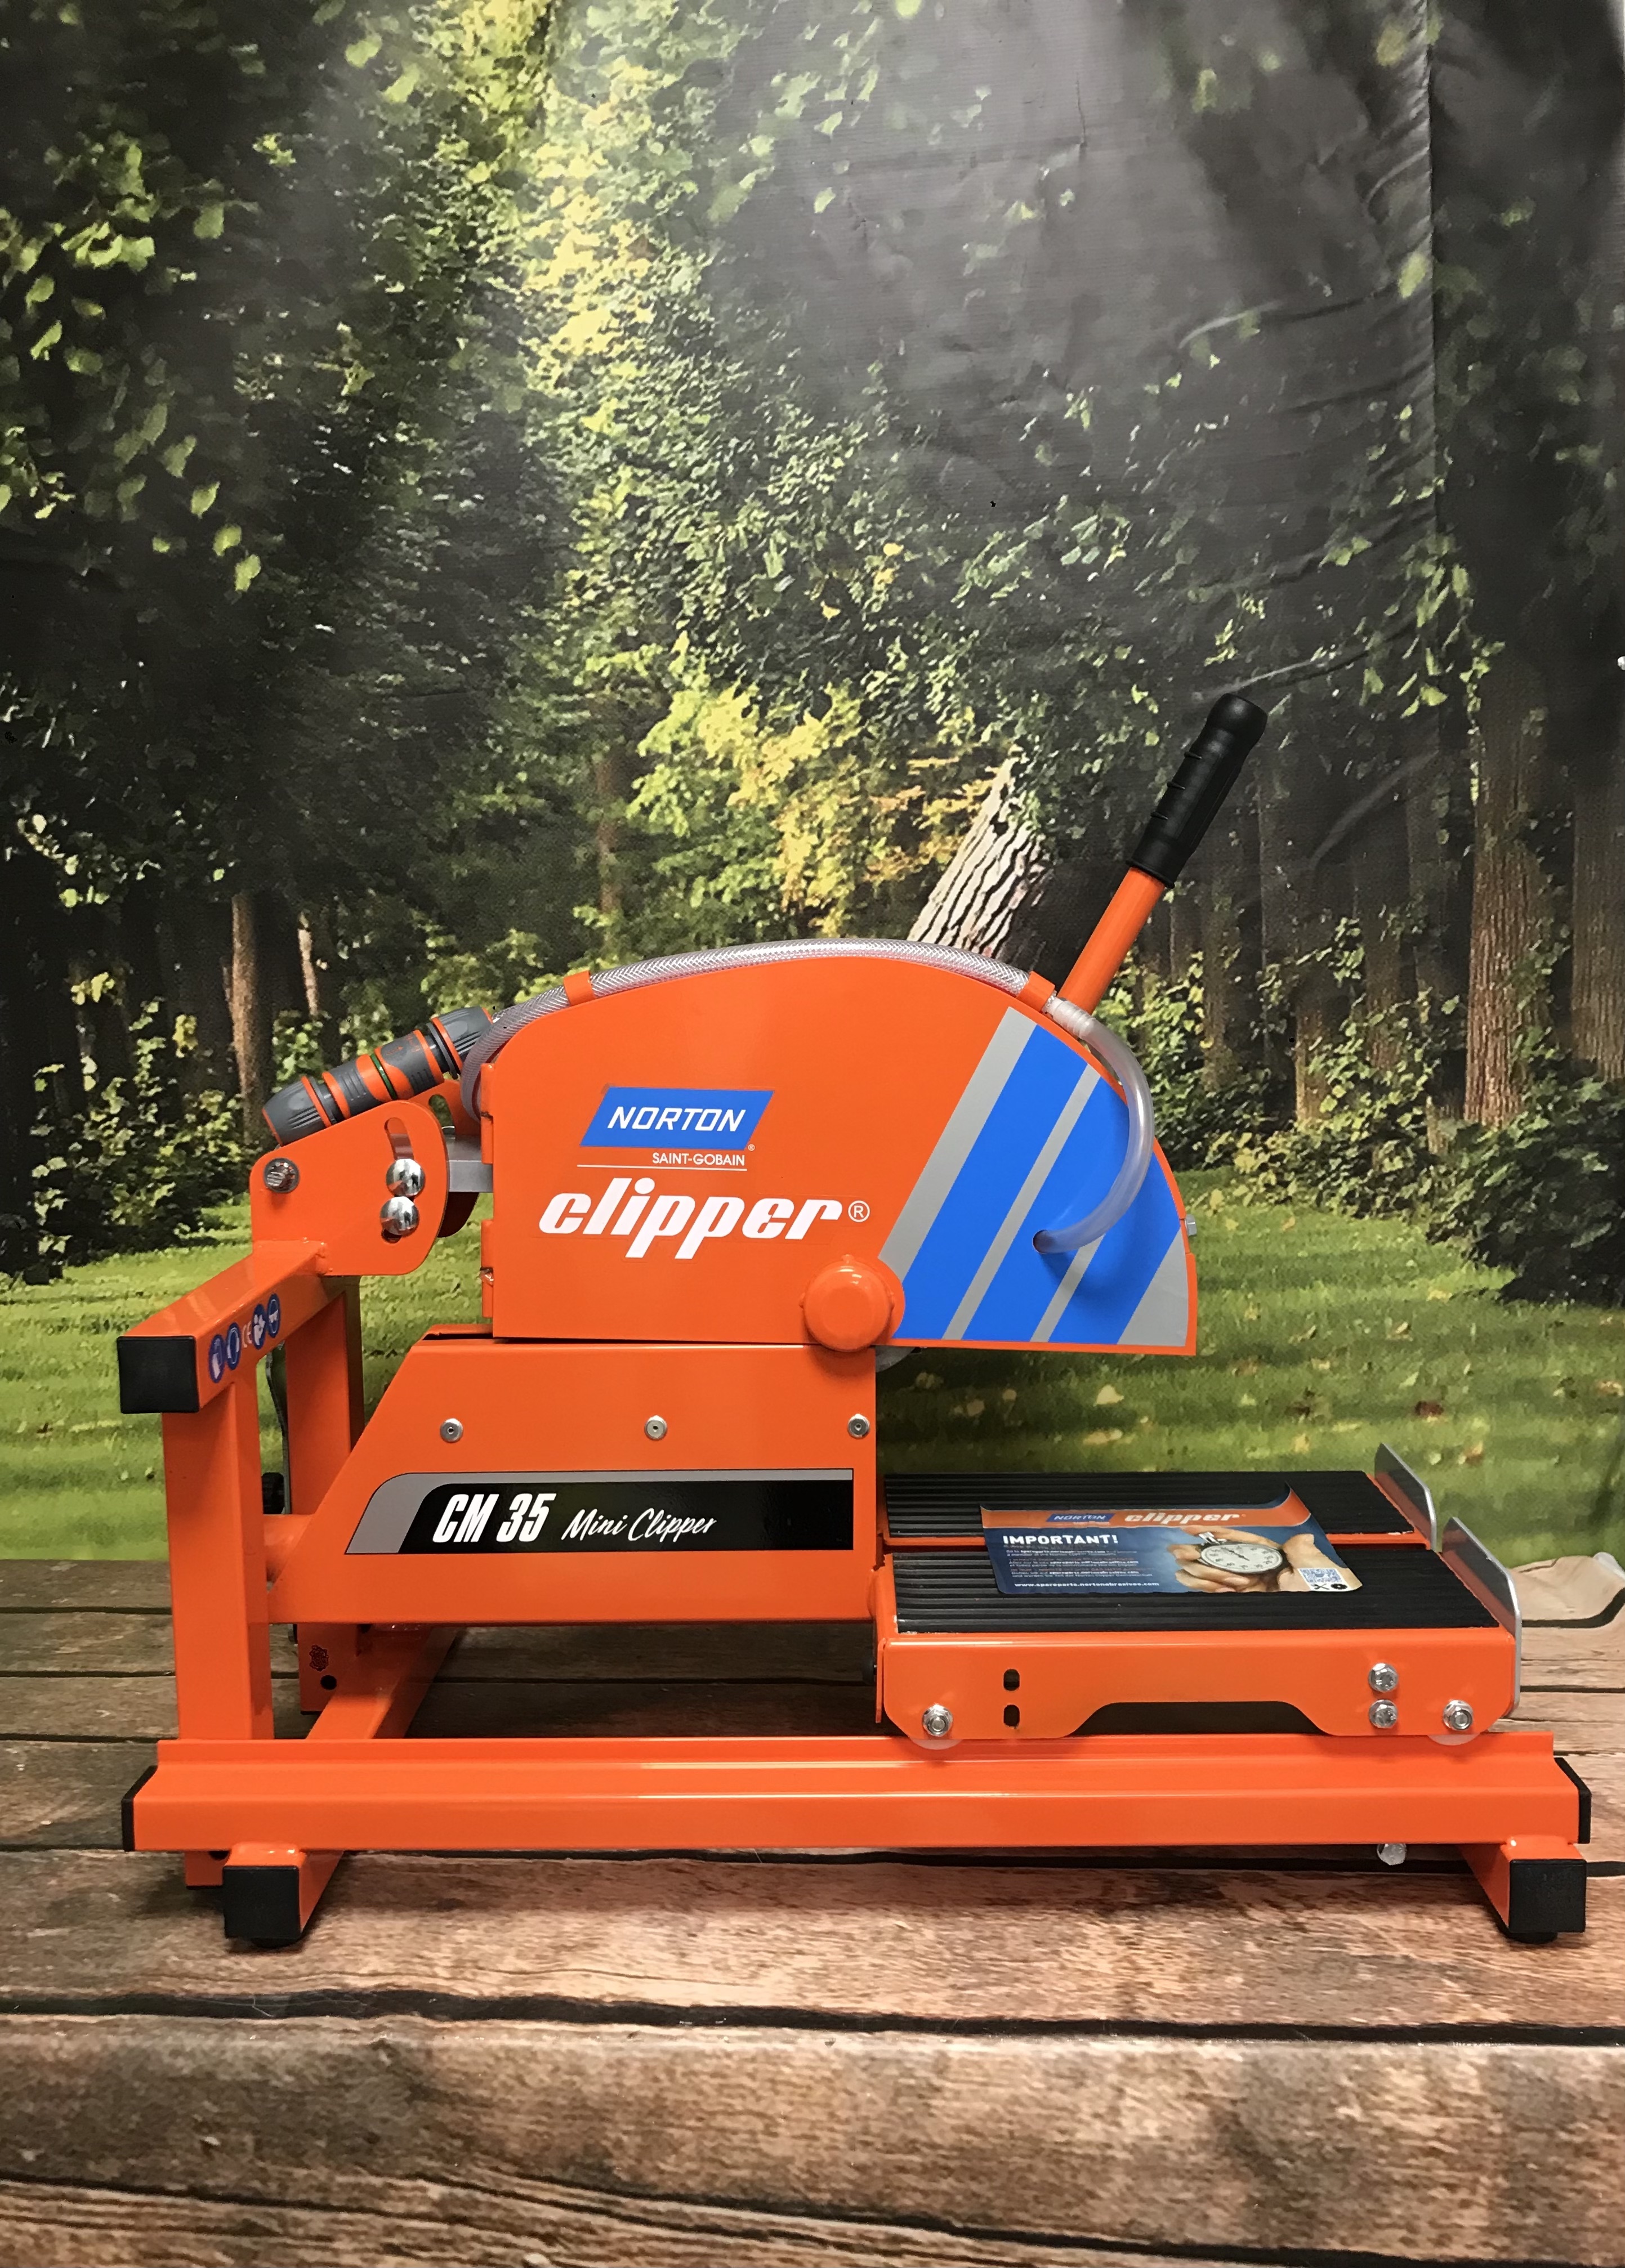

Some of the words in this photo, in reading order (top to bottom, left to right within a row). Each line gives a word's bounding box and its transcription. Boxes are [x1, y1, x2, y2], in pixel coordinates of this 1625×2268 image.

[608, 1107, 745, 1132] NORTON
[652, 1152, 745, 1166] SAINT-GOBAIN
[433, 1494, 499, 1543] CM
[496, 1493, 556, 1542] 35
[561, 1509, 627, 1541] Mini
[628, 1509, 716, 1542] Clipper
[1125, 1513, 1240, 1524] clipper
[1003, 1535, 1118, 1544] IMPORTANT!
